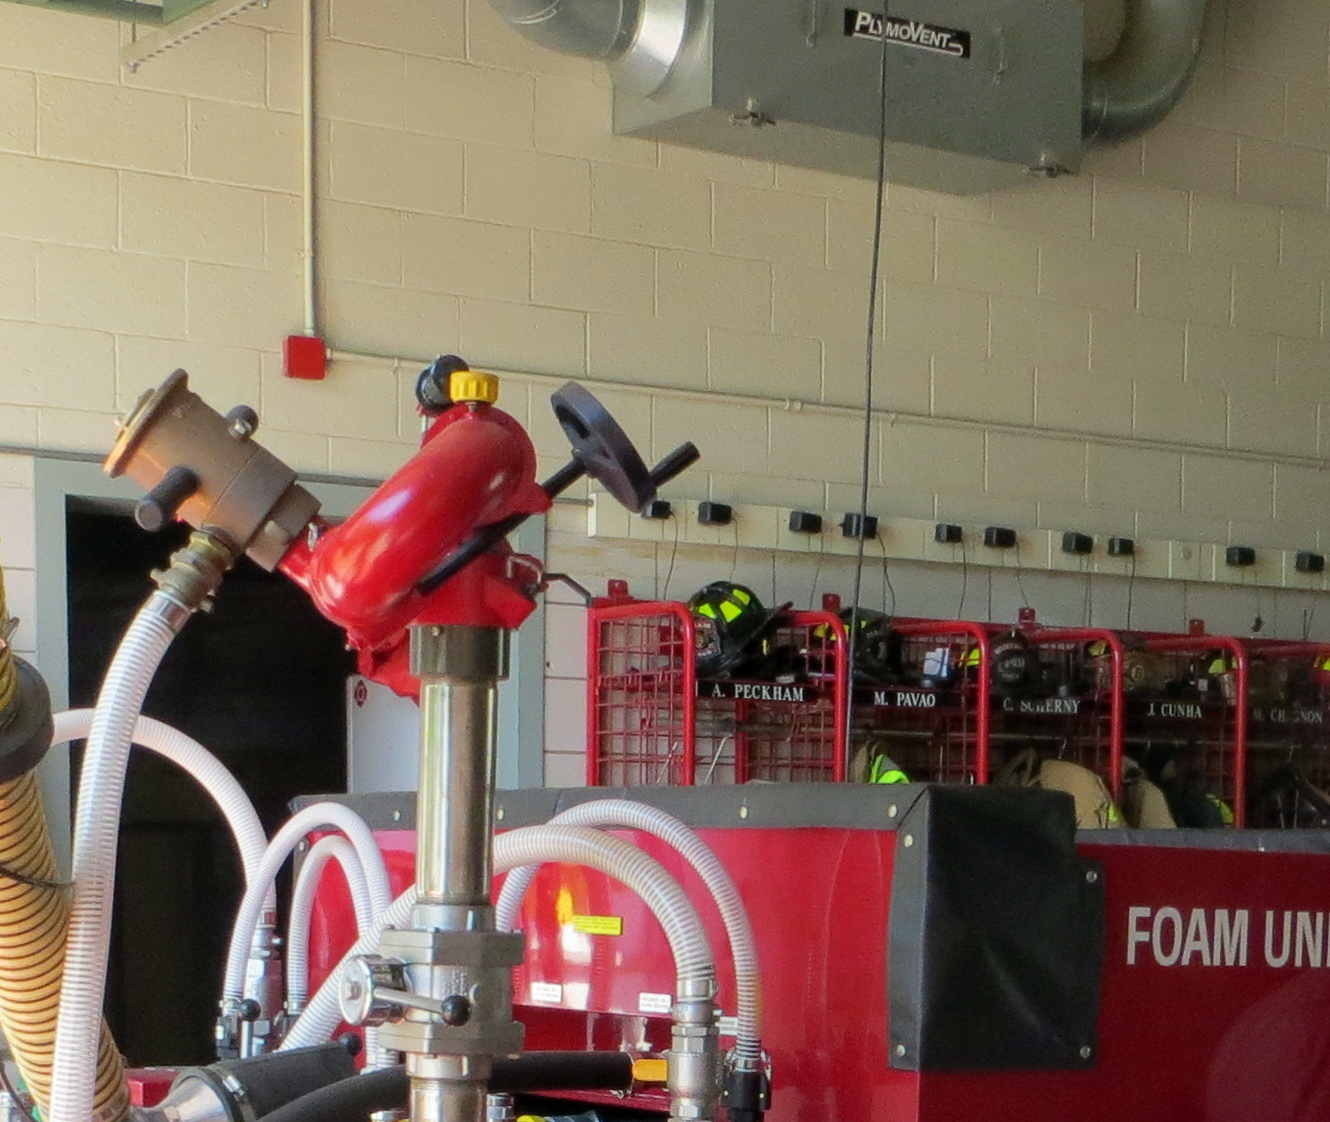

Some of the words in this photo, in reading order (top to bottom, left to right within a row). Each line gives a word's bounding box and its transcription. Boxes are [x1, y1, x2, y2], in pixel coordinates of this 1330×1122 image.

[712, 685, 726, 698] A.
[734, 684, 805, 702] PECKHAM
[874, 691, 889, 706] M.
[896, 692, 936, 707] PAVAO
[1161, 703, 1202, 718] CUNHA
[1126, 906, 1249, 967] FOAM
